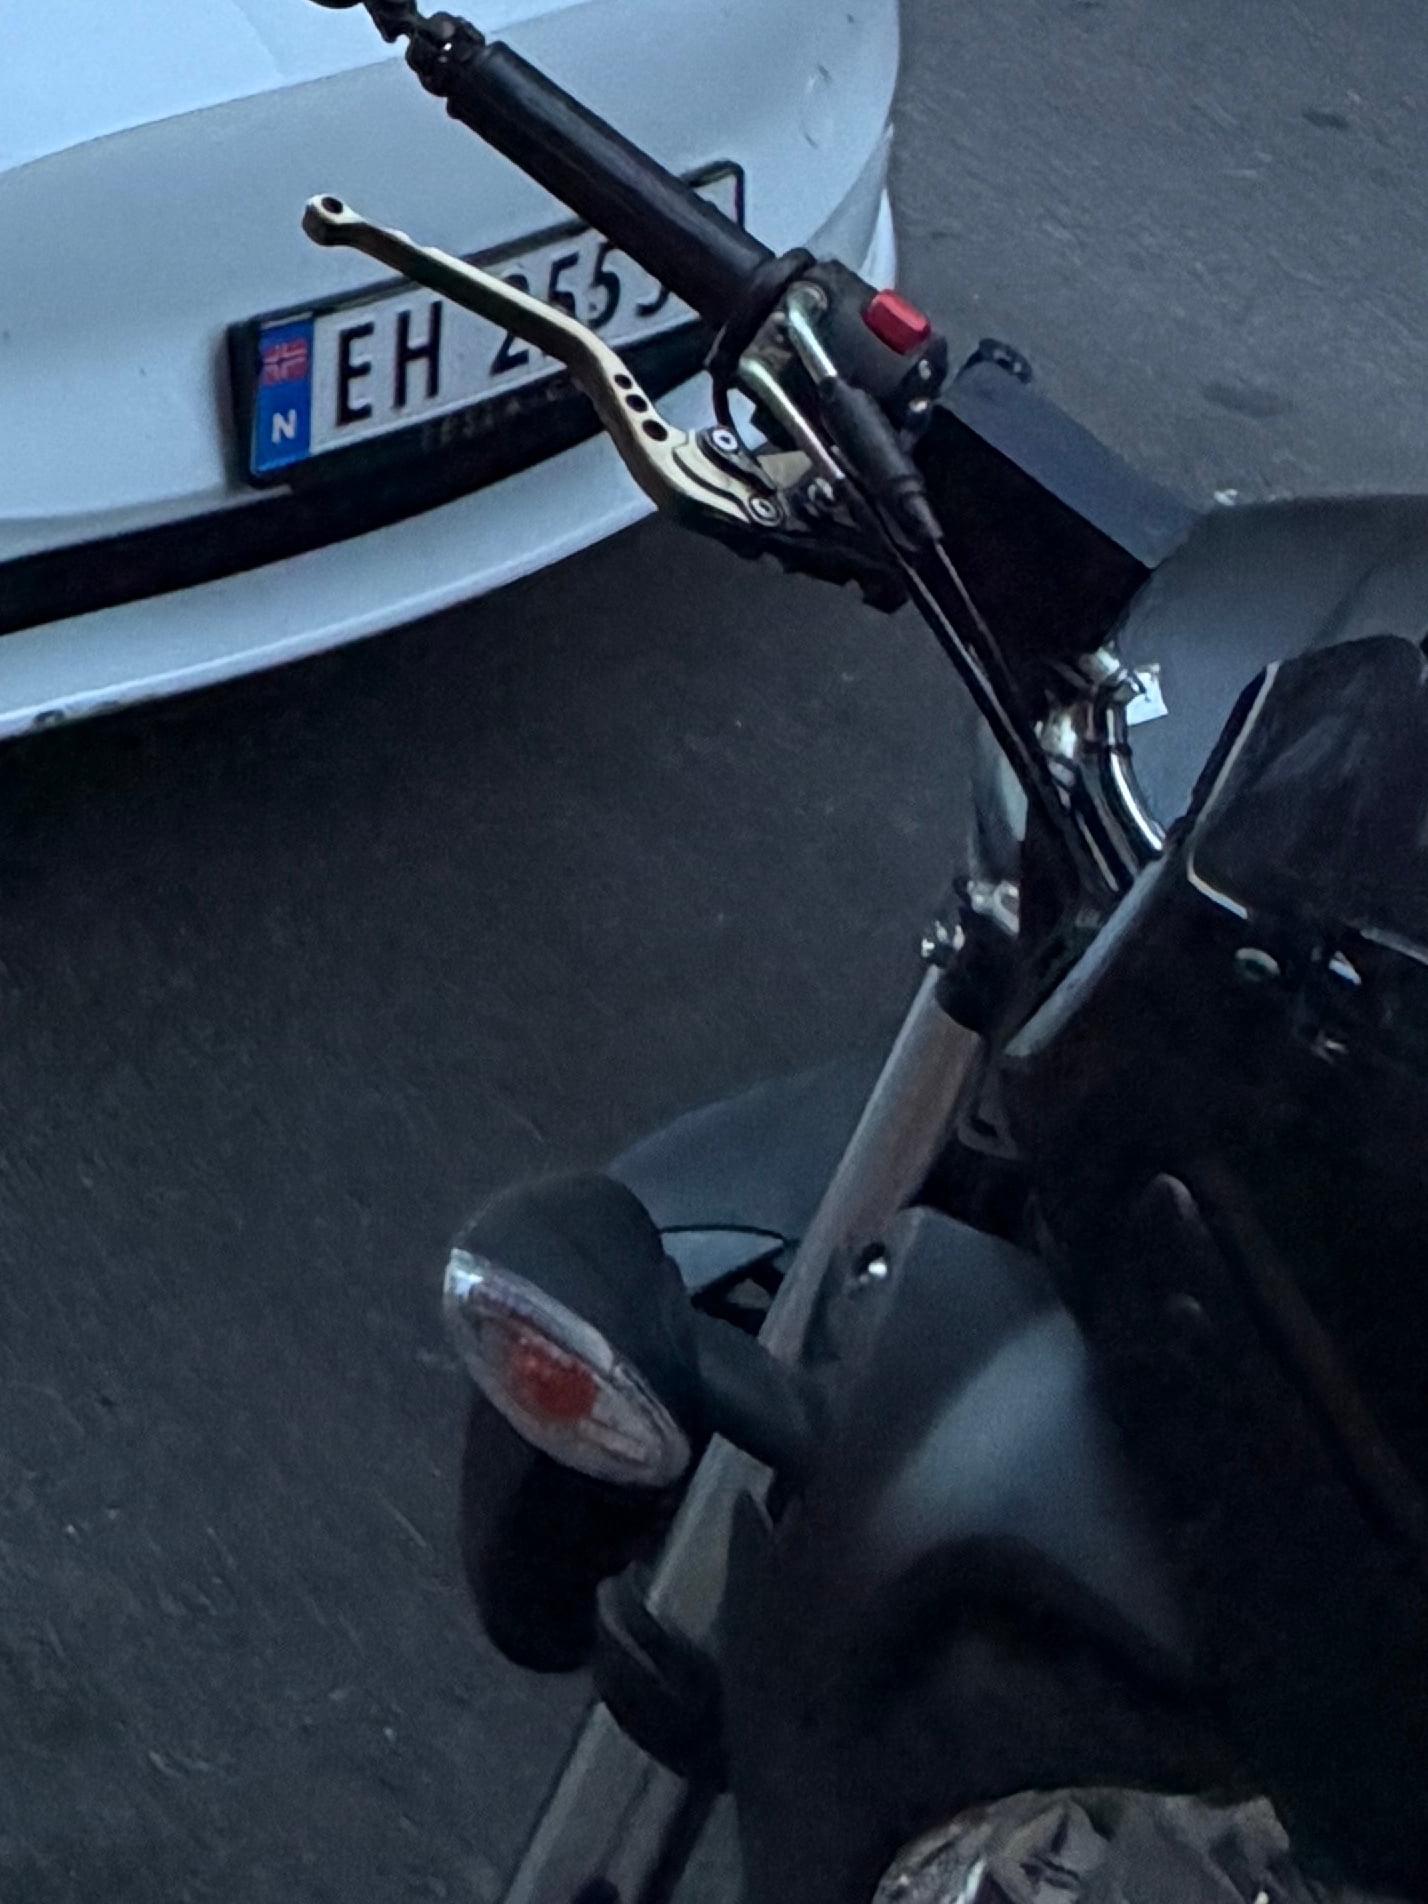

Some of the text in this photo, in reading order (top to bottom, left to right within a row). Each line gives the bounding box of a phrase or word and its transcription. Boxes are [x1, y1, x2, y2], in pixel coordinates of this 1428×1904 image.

[271, 240, 674, 444] N EH 255
